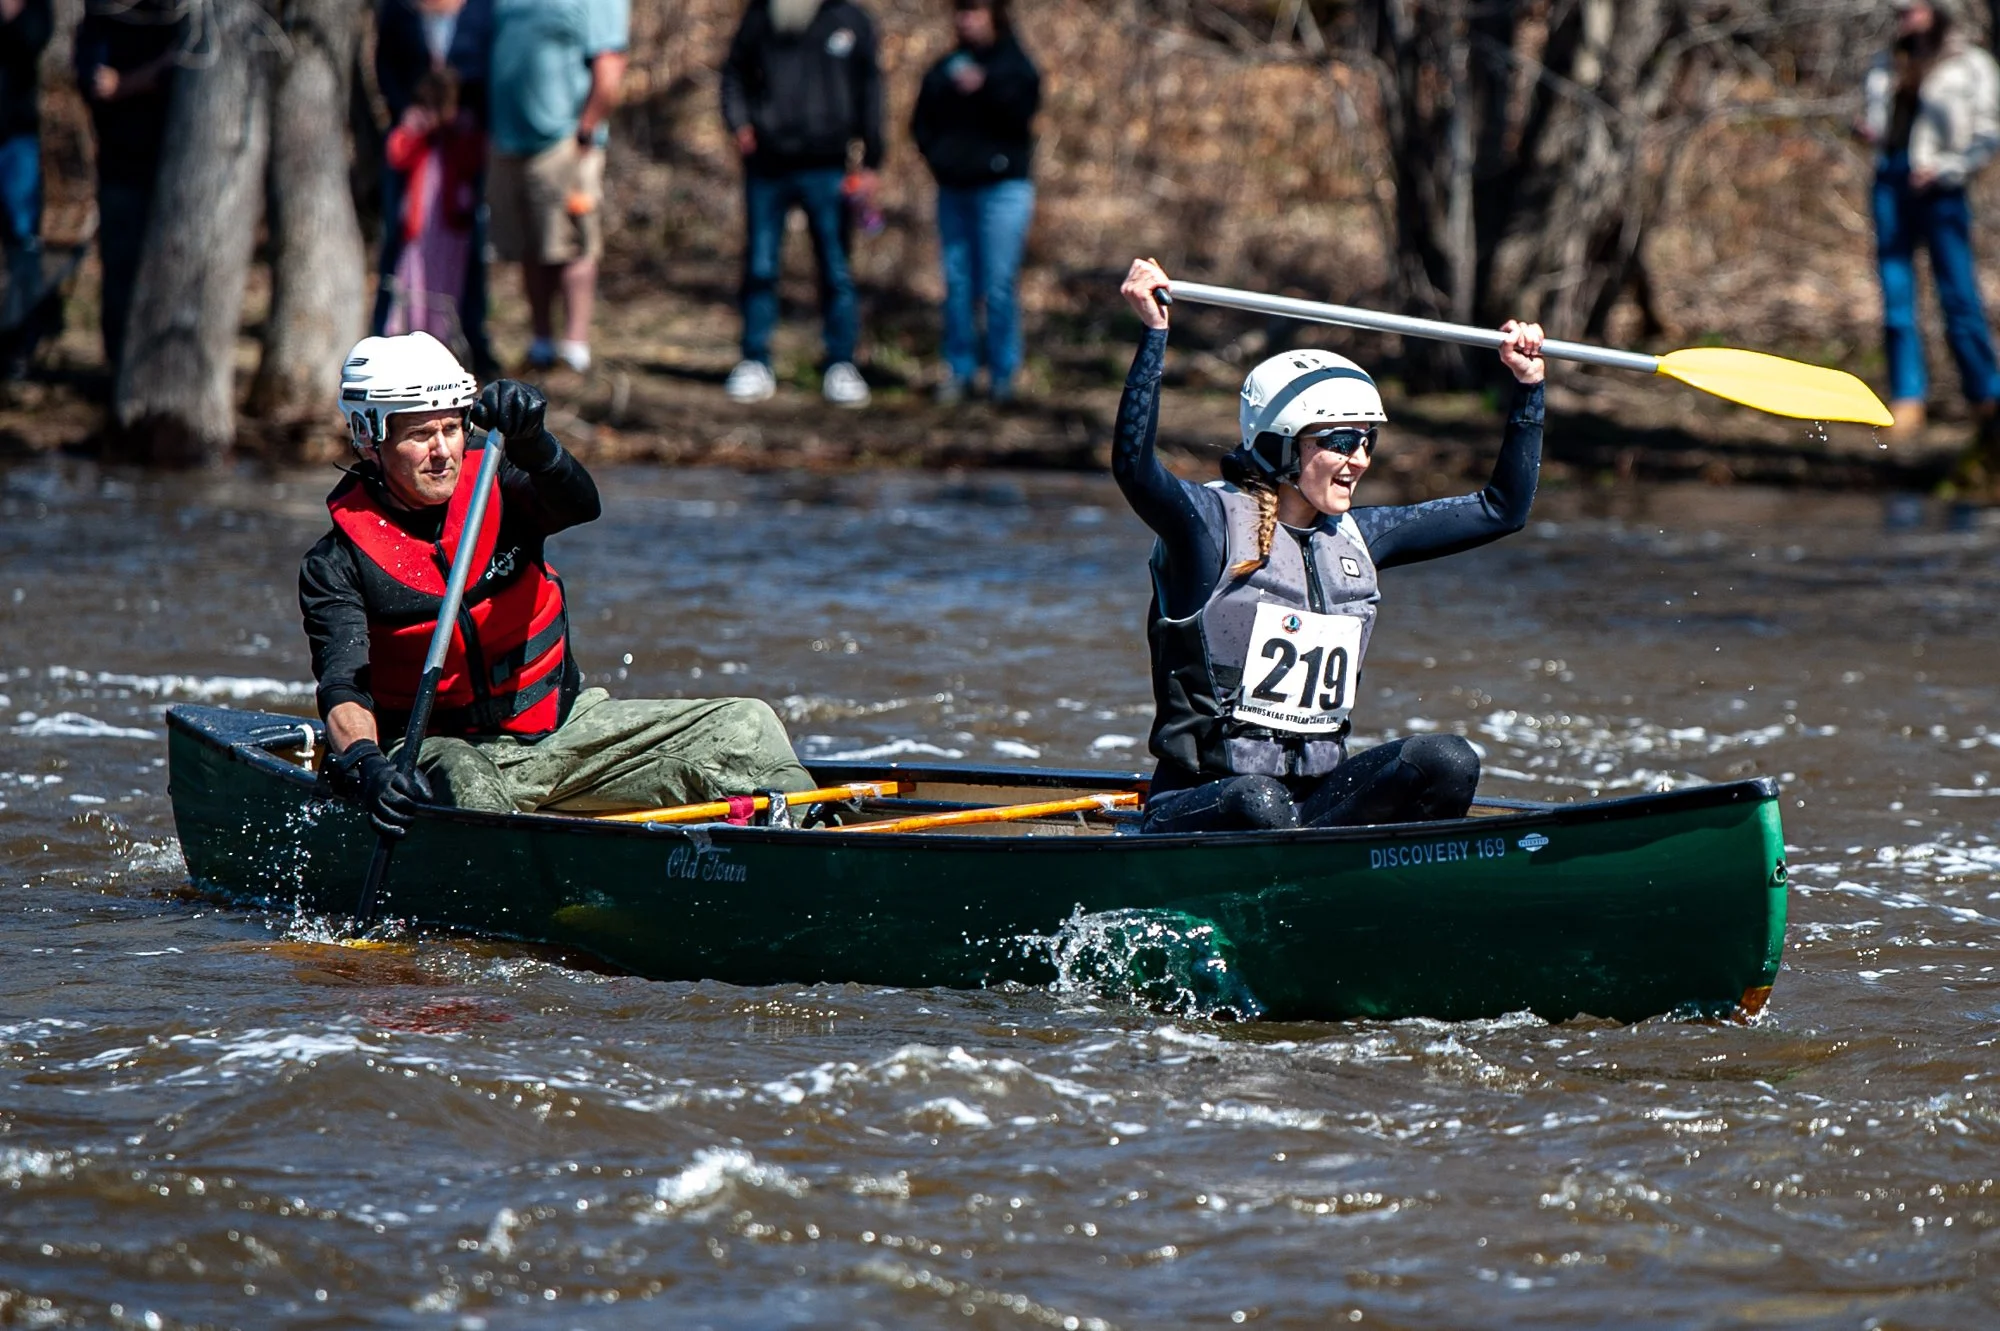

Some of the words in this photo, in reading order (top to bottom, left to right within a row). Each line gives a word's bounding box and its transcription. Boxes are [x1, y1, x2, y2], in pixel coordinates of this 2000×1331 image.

[1251, 637, 1348, 711] 219
[667, 845, 701, 880] Old
[701, 845, 747, 883] Town
[1370, 841, 1469, 869] DISCOVERY
[1475, 838, 1506, 859] 169
